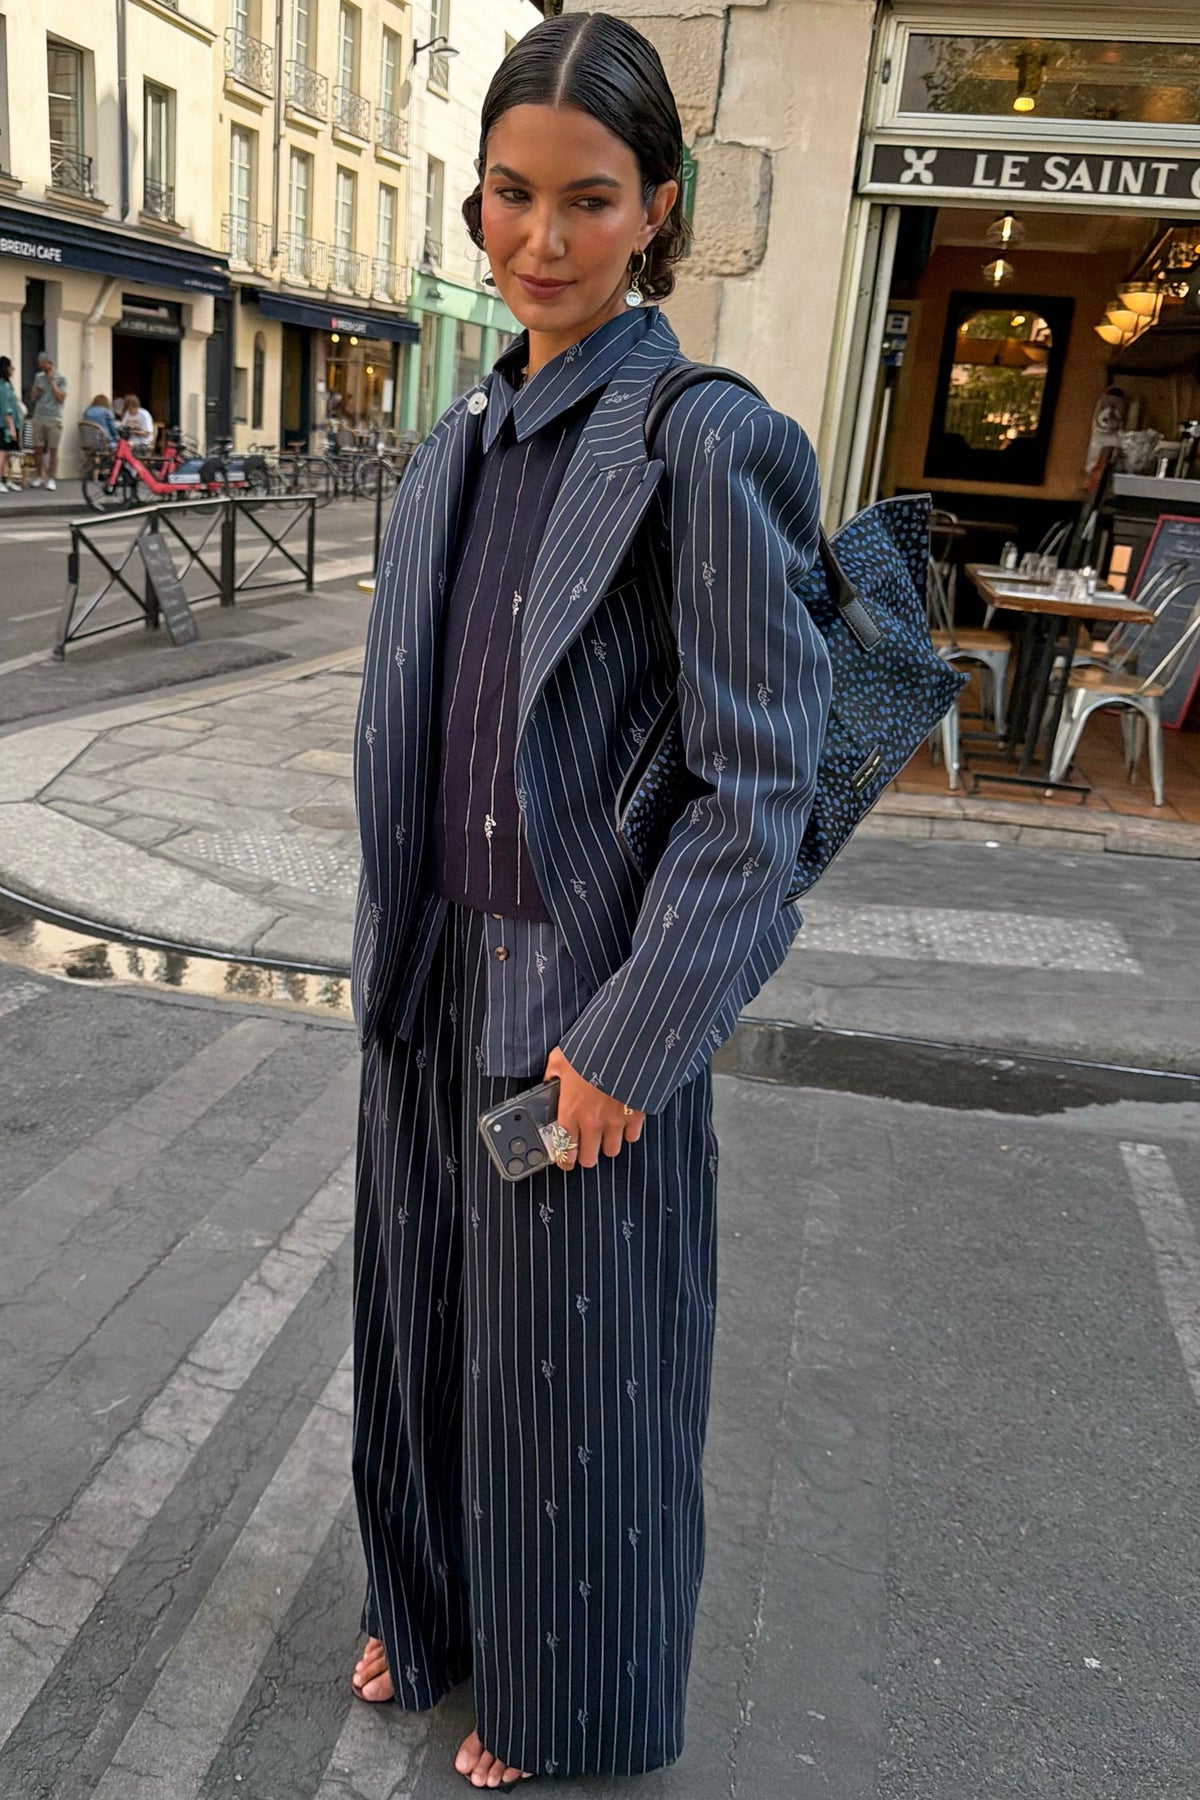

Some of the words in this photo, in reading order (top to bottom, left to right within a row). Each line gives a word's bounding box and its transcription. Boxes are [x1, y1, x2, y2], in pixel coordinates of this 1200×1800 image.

[972, 153, 1029, 188] LE
[1041, 156, 1179, 196] SAINT
[605, 391, 630, 404] Love
[702, 561, 716, 587] Love
[757, 683, 773, 706] Love
[663, 904, 679, 929] Love
[665, 1028, 681, 1050] Love
